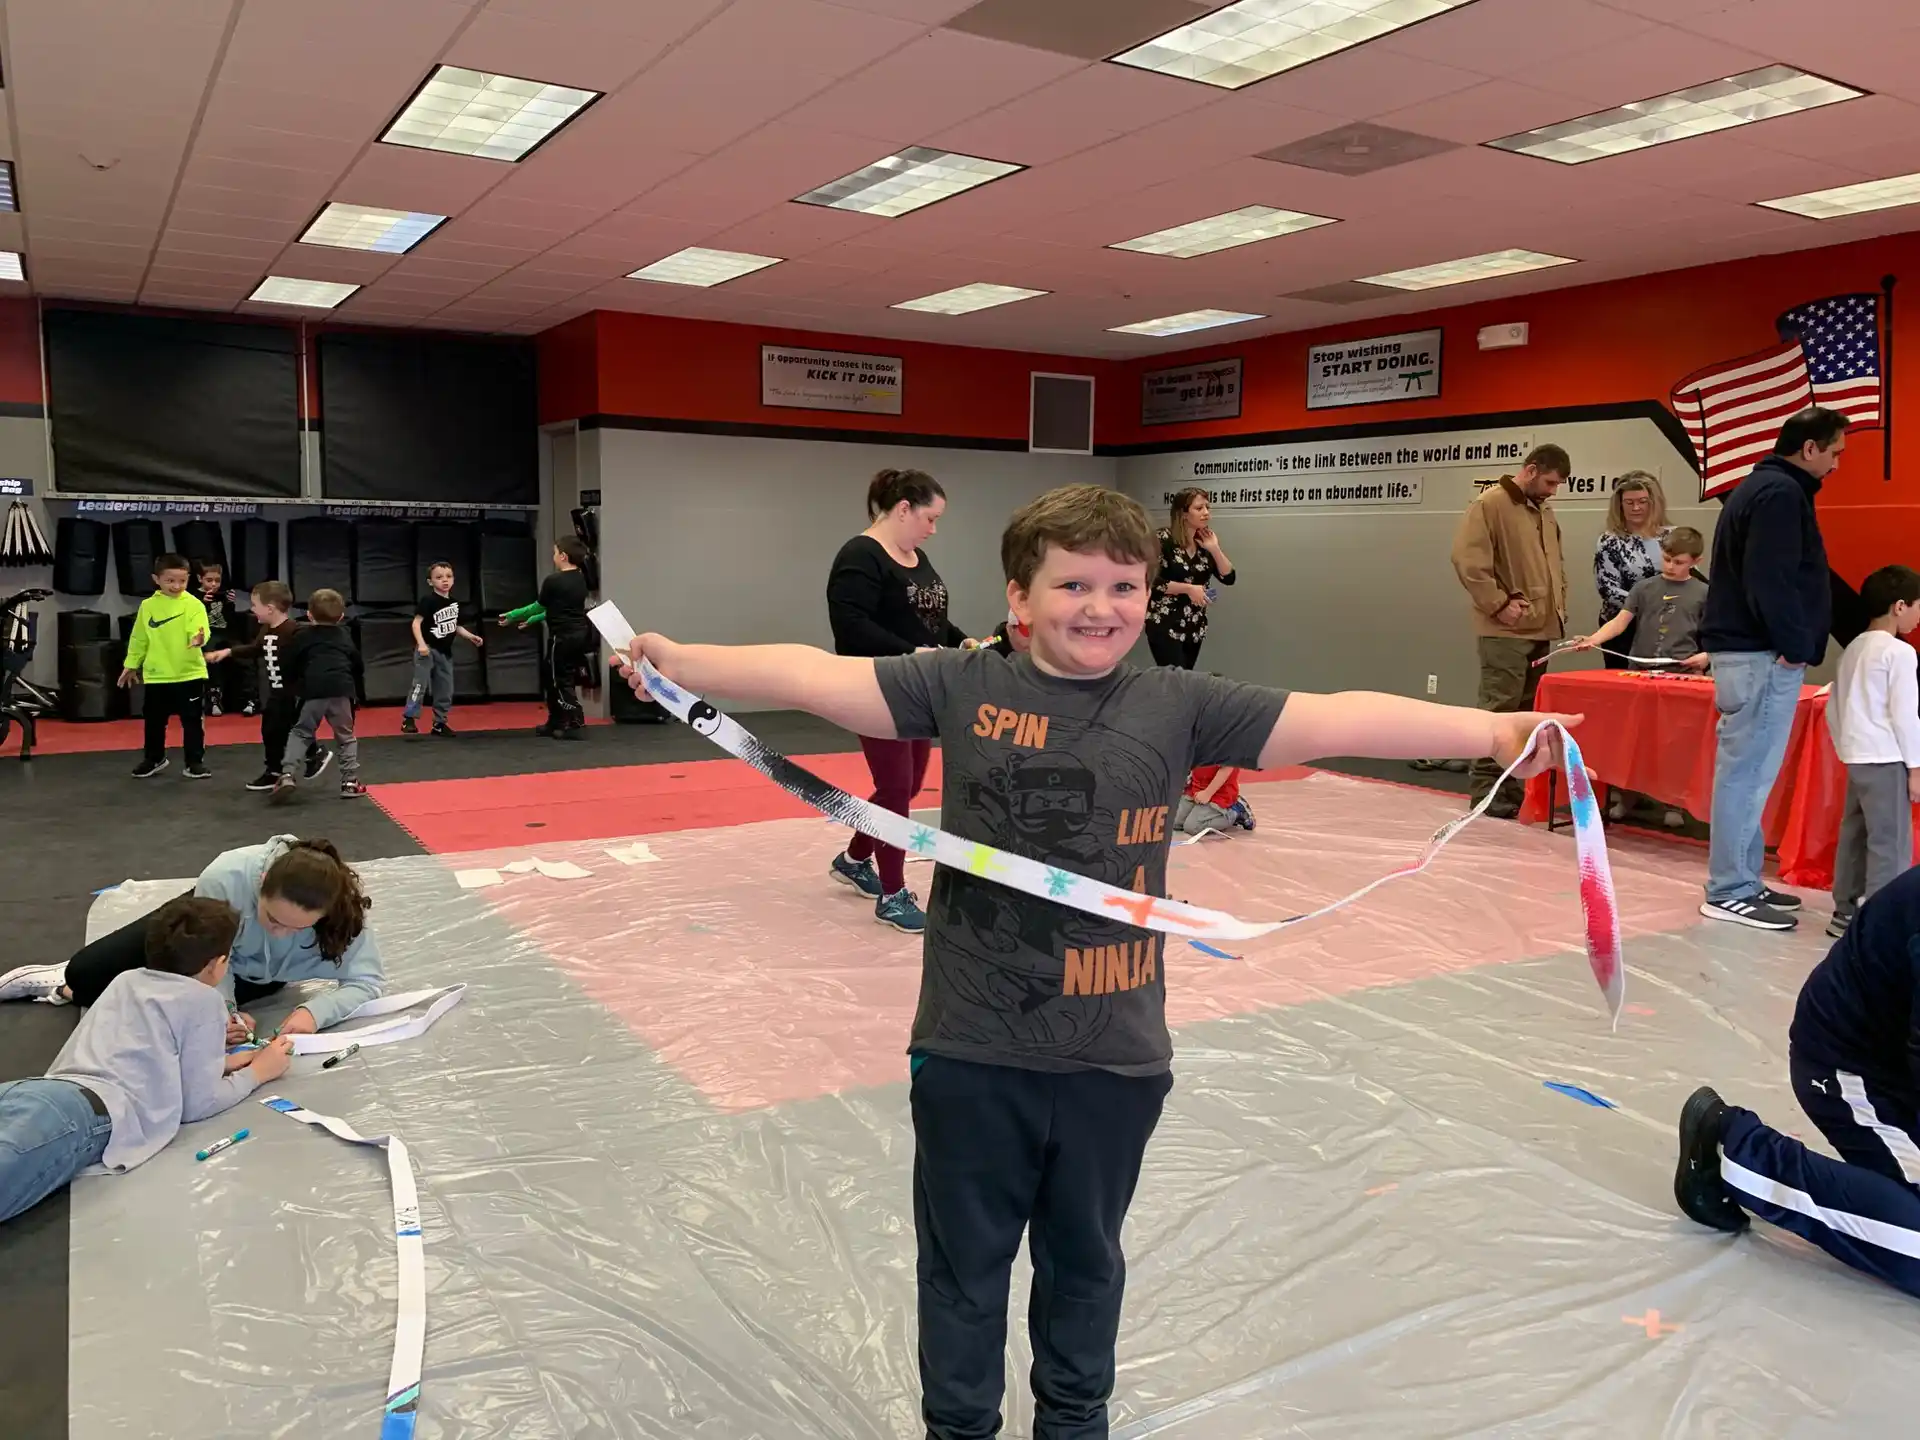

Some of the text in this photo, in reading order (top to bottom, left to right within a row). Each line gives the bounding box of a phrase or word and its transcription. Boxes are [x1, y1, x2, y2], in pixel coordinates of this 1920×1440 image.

[1313, 342, 1402, 364] Stop wishing
[832, 359, 859, 369] closes
[1322, 352, 1434, 378] START DOING.
[806, 369, 898, 386] KICK IT DOWN.
[1292, 455, 1311, 470] the
[1314, 453, 1336, 468] link
[1339, 450, 1392, 467] Between
[1396, 448, 1419, 464] the
[1423, 444, 1461, 463] world
[1465, 442, 1491, 460] and
[1220, 489, 1237, 503] the
[1239, 489, 1263, 502] first
[1265, 488, 1289, 504] step
[1292, 487, 1304, 501] to
[1308, 487, 1322, 501] an
[1325, 484, 1383, 500] abundant
[1600, 475, 1606, 492] I
[77, 500, 257, 514] Leadership Punch Shield
[326, 505, 480, 519] Leadership Kick Shield
[973, 703, 1049, 750] SPIN
[1117, 805, 1170, 846] LIKE
[1062, 936, 1157, 998] NINJA
